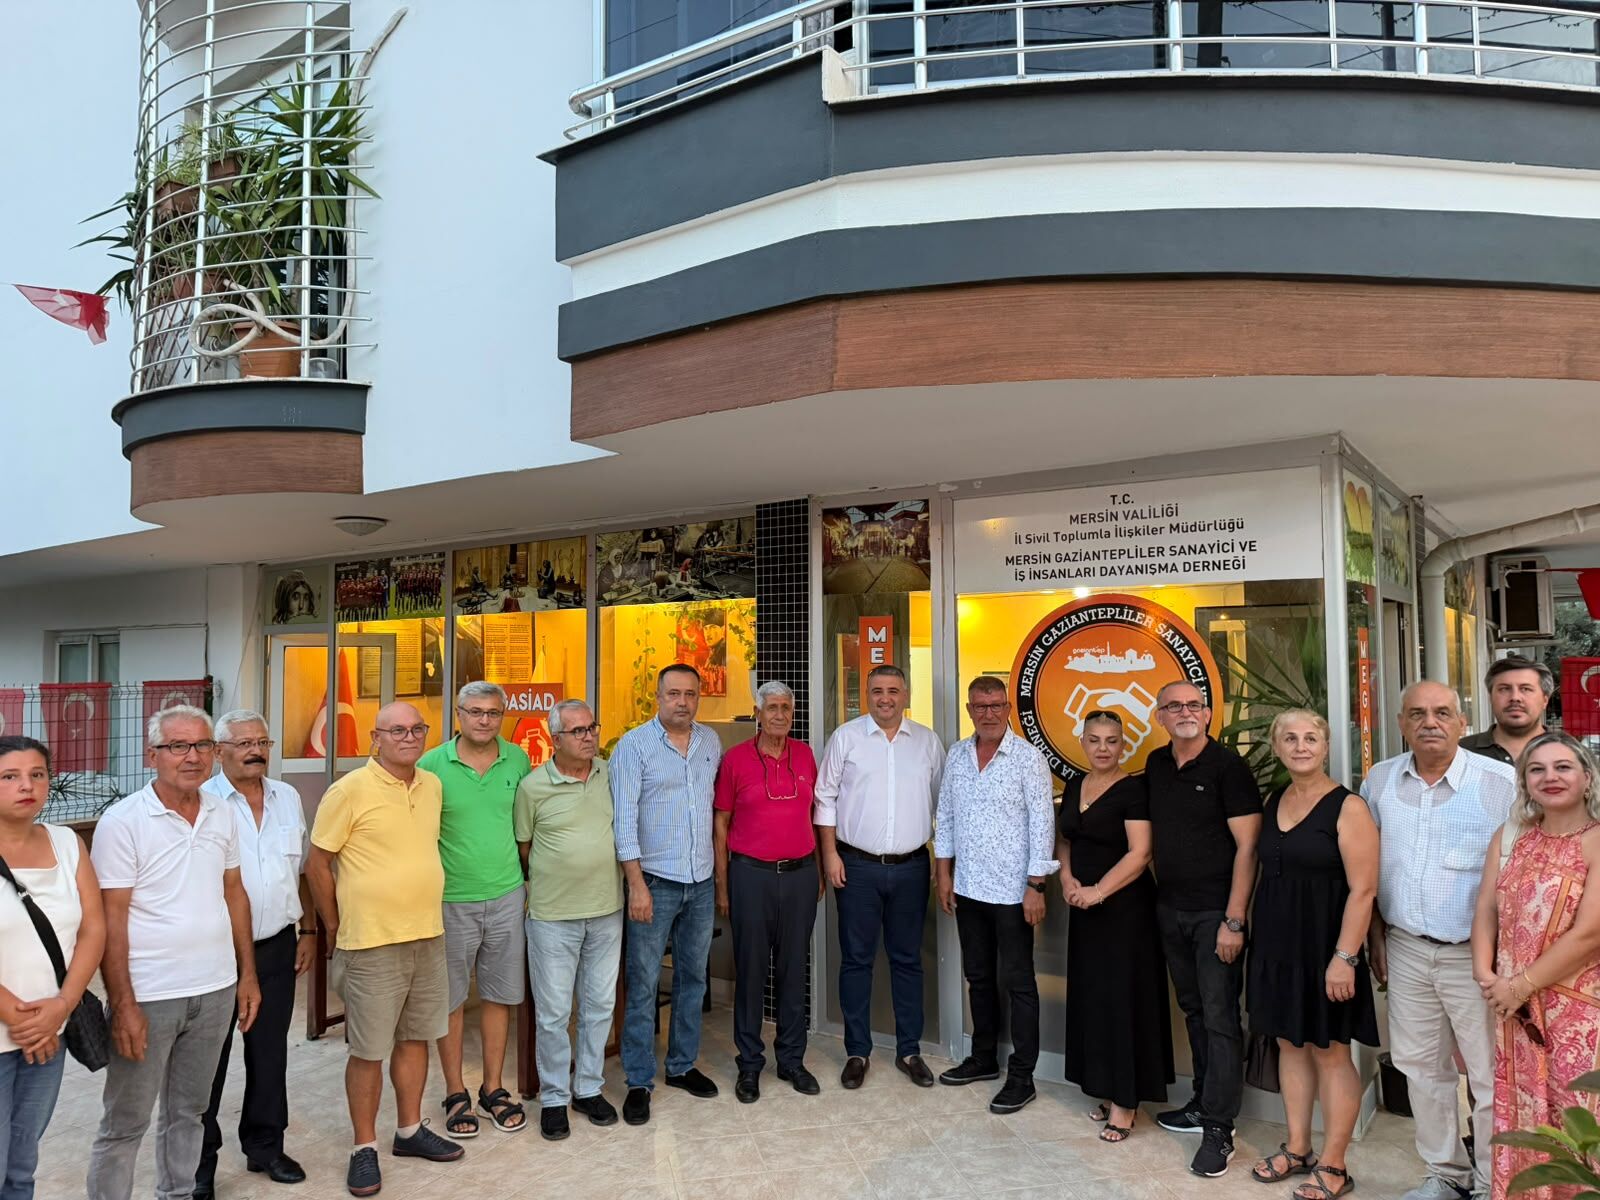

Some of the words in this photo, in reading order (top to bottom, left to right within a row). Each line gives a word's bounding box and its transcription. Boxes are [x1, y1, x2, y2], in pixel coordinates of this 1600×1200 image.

[1110, 494, 1134, 505] T.C.
[1070, 509, 1119, 525] MERSİN
[1122, 503, 1179, 521] VALİLİĞİ
[1014, 532, 1022, 544] İl
[1025, 532, 1050, 544] Sivil
[1053, 528, 1111, 543] Toplumla
[1115, 524, 1165, 538] İlişkiler
[1169, 518, 1244, 534] Müdürlüğü
[1005, 551, 1051, 566] MERSİN
[1055, 545, 1165, 563] GAZİANTEPLİLER
[1169, 539, 1235, 557] SANAYİCİ
[1239, 540, 1257, 552] VE
[1014, 568, 1025, 582] İŞ
[1029, 567, 1096, 580] İNSANLARI
[1100, 562, 1179, 577] DAYANIŞMA
[1182, 555, 1246, 573] DERNEĞİ
[868, 626, 887, 665] ME
[1020, 645, 1045, 697] MERSİN
[1042, 607, 1155, 646] GAZİANTEPLİLER
[1155, 623, 1207, 684] SANAYİCİ
